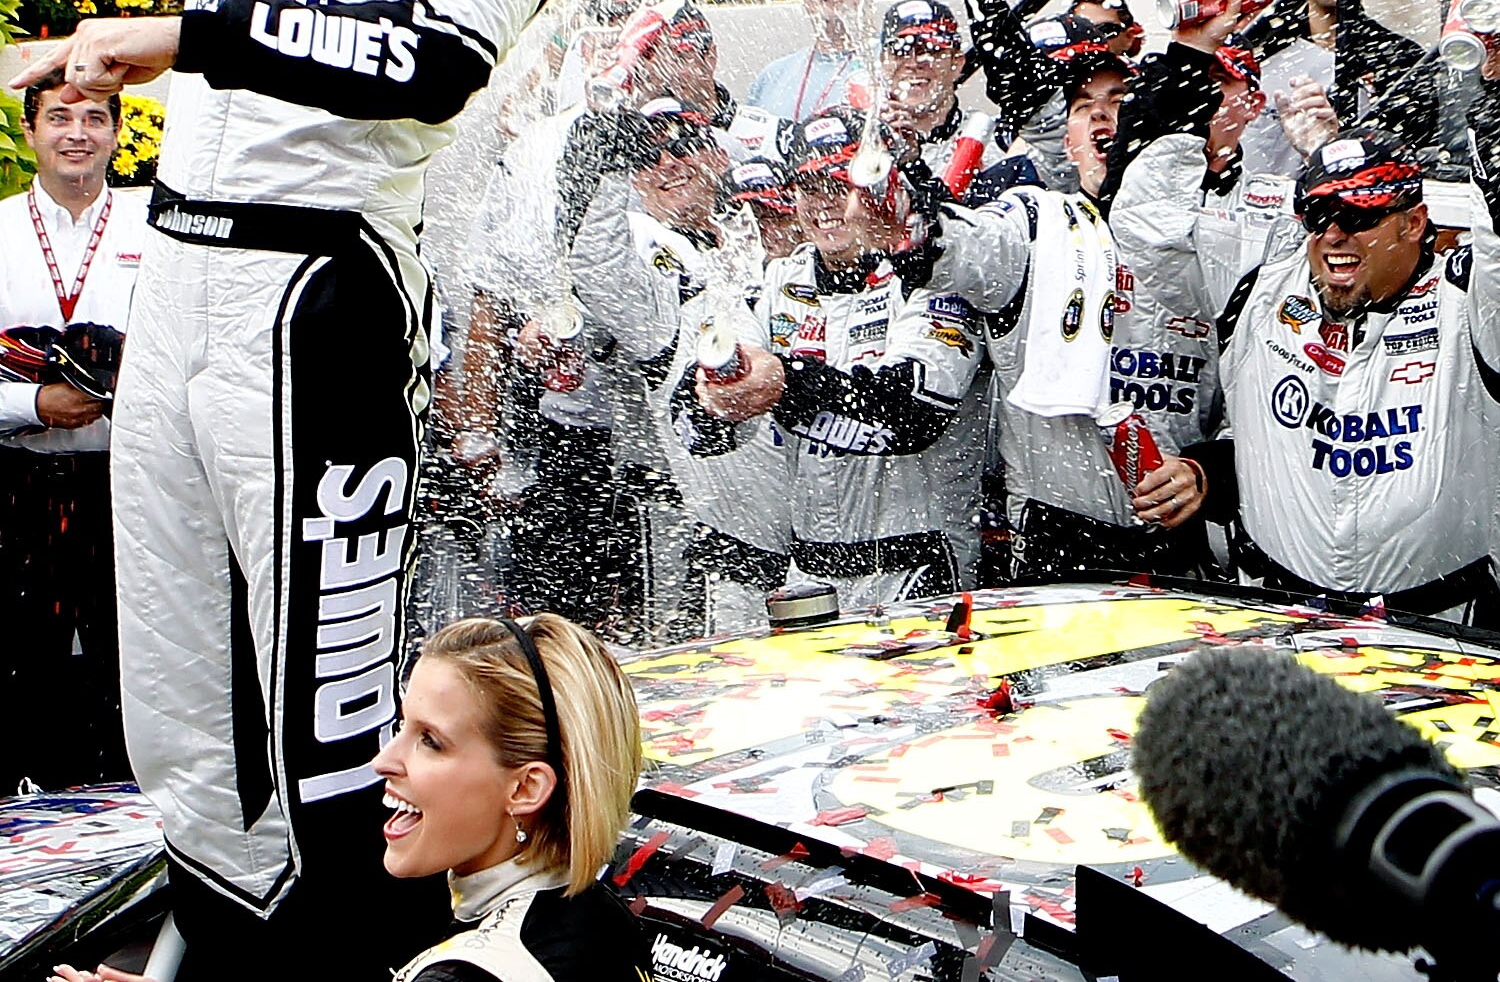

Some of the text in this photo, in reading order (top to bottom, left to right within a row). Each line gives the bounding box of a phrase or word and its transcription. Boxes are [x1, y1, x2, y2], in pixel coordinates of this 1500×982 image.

[249, 0, 422, 83] LOWE'S
[1075, 248, 1086, 282] Sprint
[1403, 311, 1436, 325] TOOLS
[1385, 341, 1403, 350] TOP
[1110, 346, 1208, 385] OBALT
[1110, 377, 1197, 416] TOOLS
[790, 410, 896, 452] LOWE'S
[1306, 404, 1422, 443] KOBALT
[1310, 439, 1414, 478] TOOLS
[299, 455, 409, 804] LOWE'S
[650, 932, 727, 982] Hendrick
